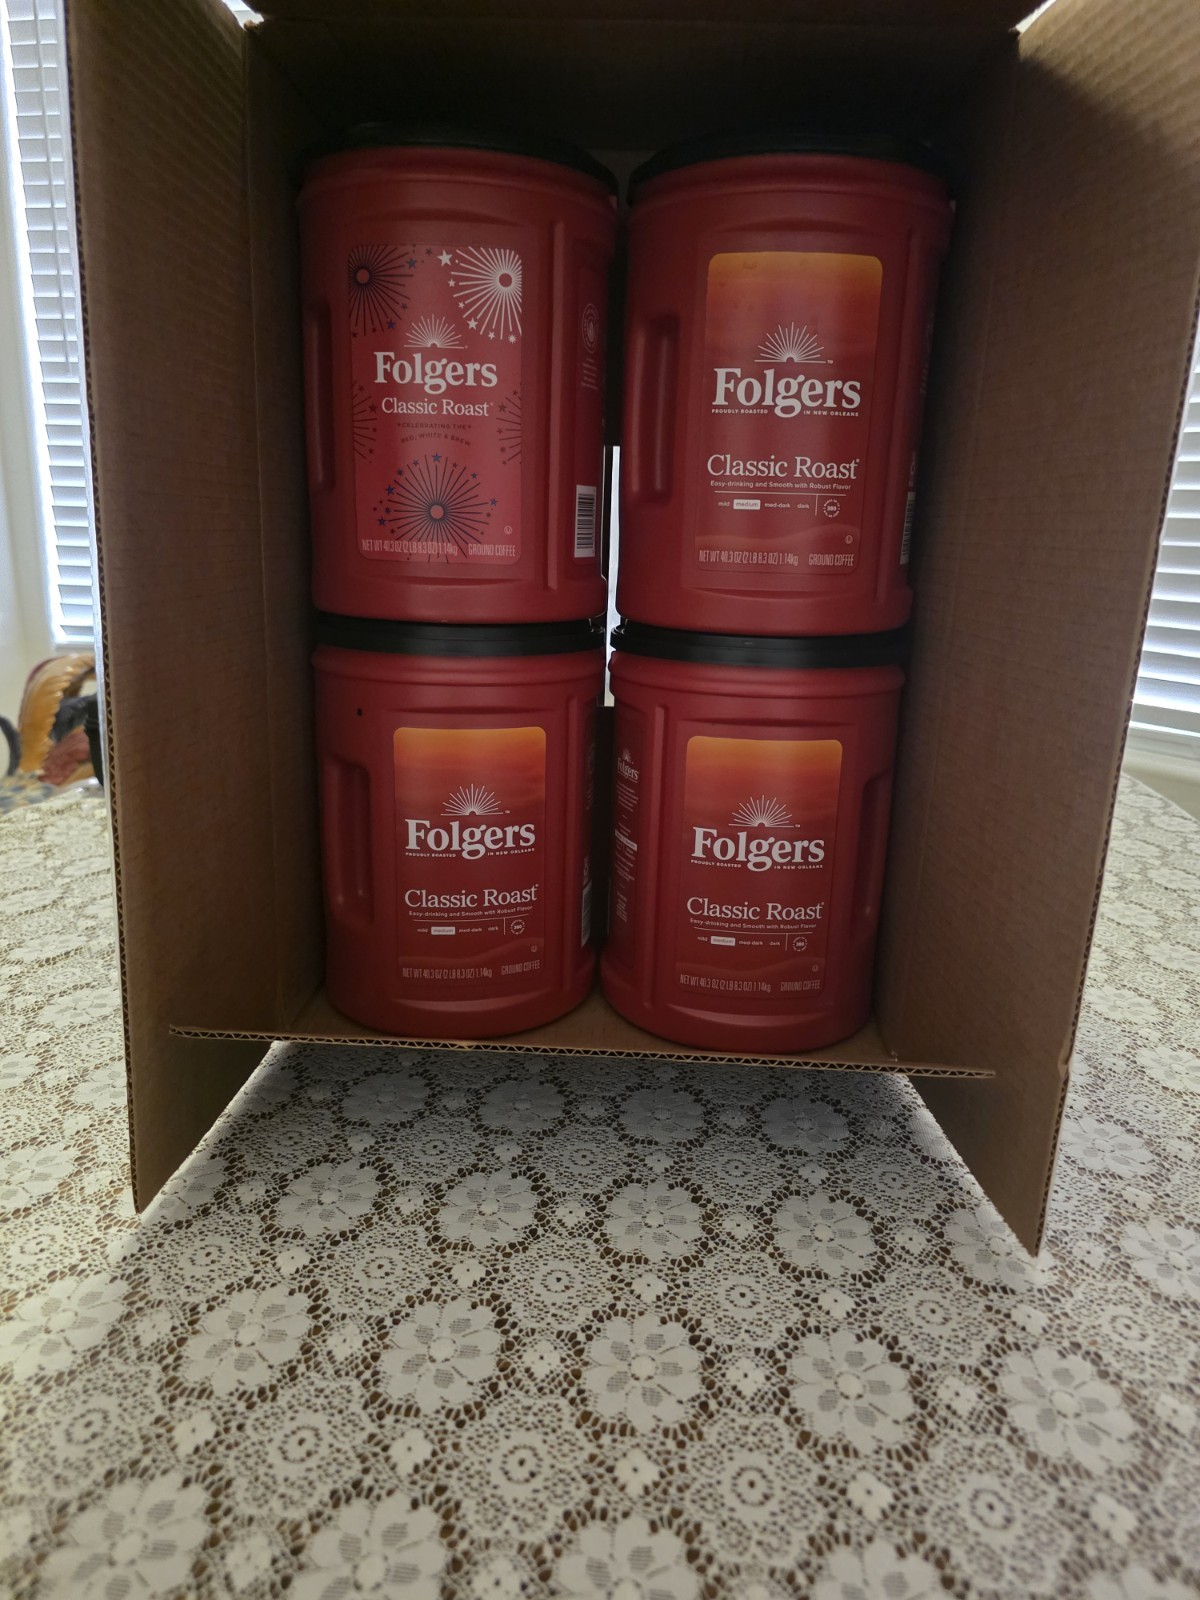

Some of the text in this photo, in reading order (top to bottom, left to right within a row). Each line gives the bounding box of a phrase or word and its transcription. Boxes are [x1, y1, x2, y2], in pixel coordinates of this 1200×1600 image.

[373, 351, 498, 395] Folgers
[712, 367, 861, 418] Folgers
[381, 397, 490, 417] Classic Roast
[402, 422, 451, 430] CELEBRATING
[707, 454, 858, 480] Classic Roast
[710, 480, 754, 488] Easy-drinking
[810, 482, 831, 490] Robust
[468, 543, 516, 556] GROUND COFFEE
[699, 550, 710, 562] NET
[710, 550, 720, 562] WT
[808, 554, 854, 566] GROUND COFFEE
[405, 819, 536, 860] Folgers
[691, 826, 825, 872] Folgers
[404, 885, 538, 908] Classic Roast
[408, 910, 448, 918] Easy-drinking
[686, 896, 823, 920] Classic Roast
[690, 918, 728, 928] Easy-drinking
[501, 960, 540, 976] GROUND COFFEE
[680, 974, 690, 984] NET
[780, 980, 820, 992] GROUND COFFEE
